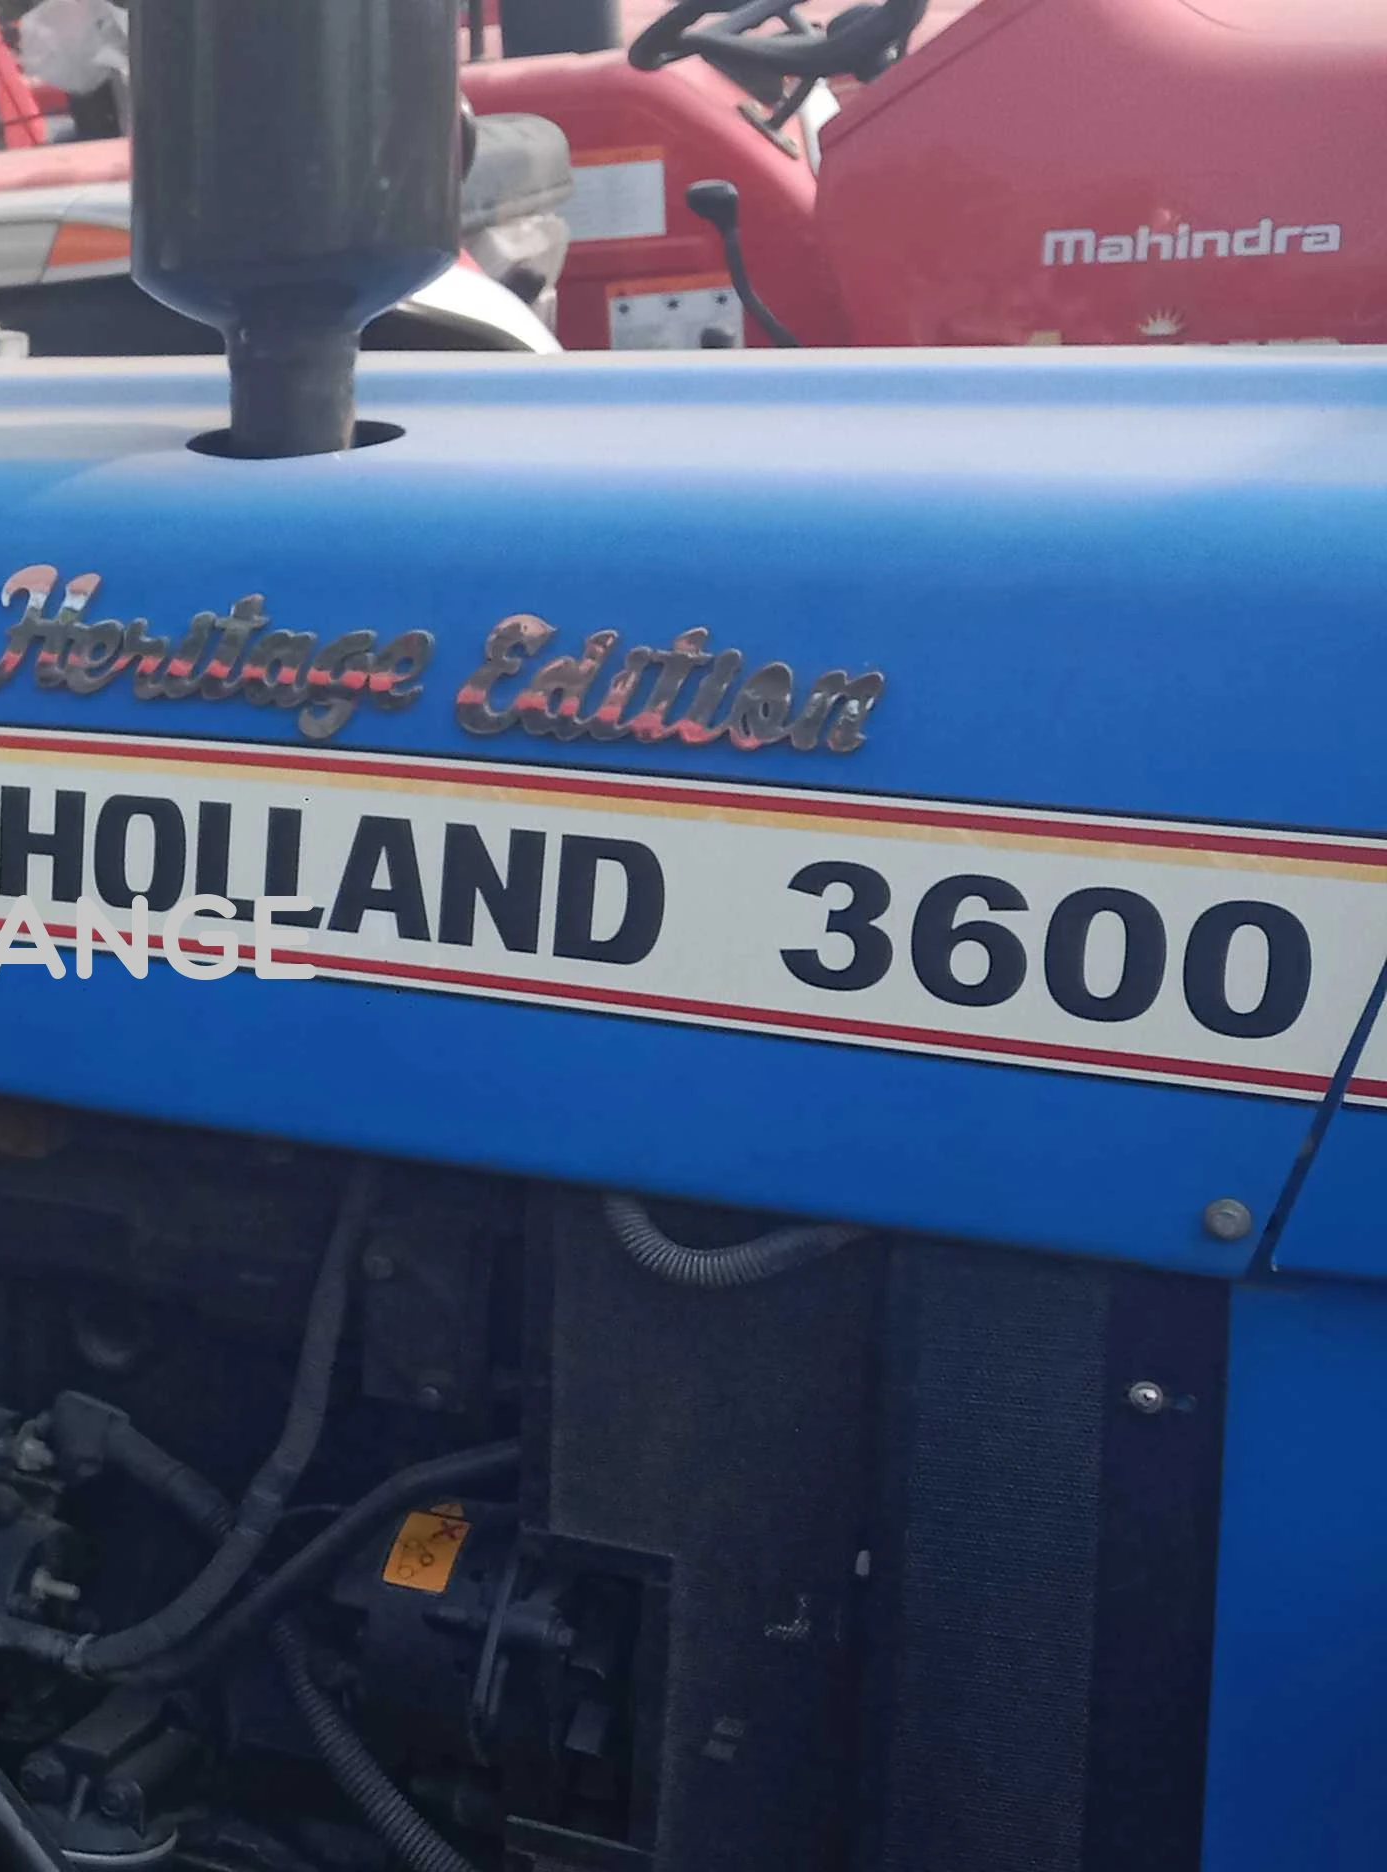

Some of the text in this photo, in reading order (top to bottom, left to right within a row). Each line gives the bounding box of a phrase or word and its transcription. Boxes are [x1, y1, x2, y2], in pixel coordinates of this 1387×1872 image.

[1042, 218, 1340, 265] Mahindra
[456, 613, 885, 753] Edition
[779, 860, 1312, 1038] 3600
